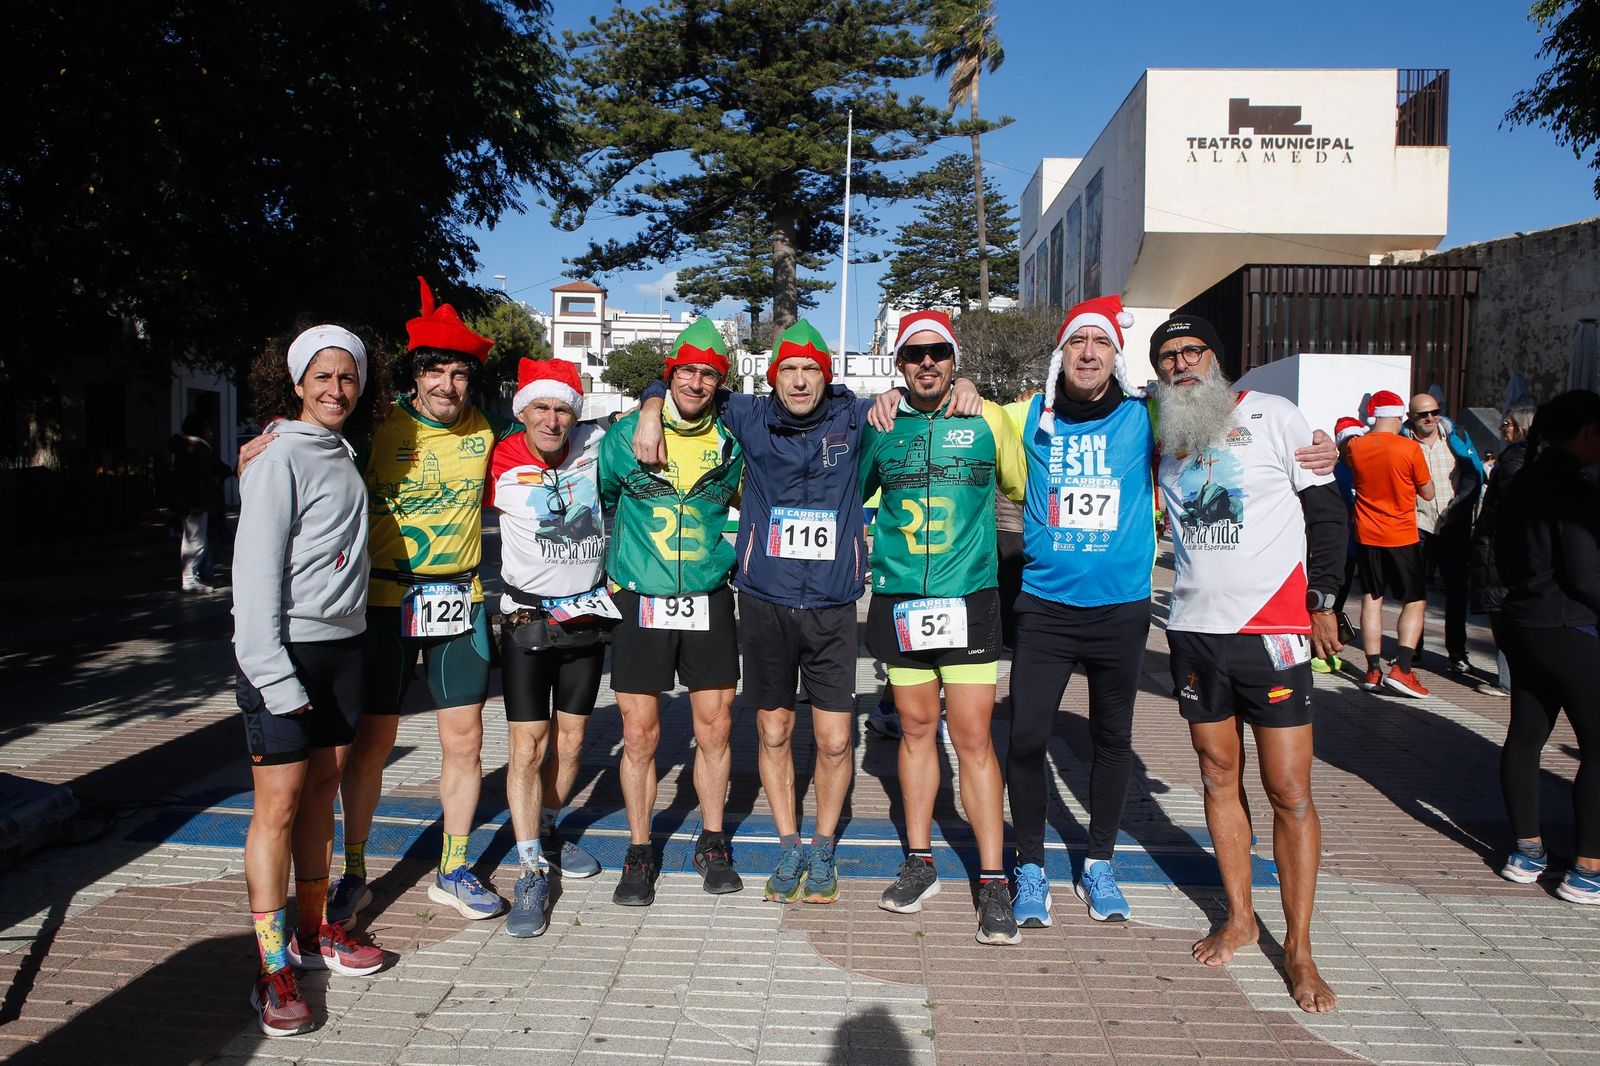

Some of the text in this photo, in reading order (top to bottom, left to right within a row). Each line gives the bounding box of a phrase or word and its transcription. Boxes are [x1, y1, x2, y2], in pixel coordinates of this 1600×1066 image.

[1187, 137, 1354, 150] TEATRO MUNICIPAL
[1187, 151, 1353, 164] ALAMEDA
[1067, 435, 1107, 453] SAN
[1066, 451, 1112, 477] SIL
[1065, 477, 1118, 487] CARRERA
[787, 510, 835, 519] CARRERA
[1064, 493, 1111, 516] 137
[785, 525, 828, 547] 116
[1210, 519, 1240, 544] vida
[538, 539, 565, 559] Vive
[566, 538, 579, 560] la
[422, 600, 465, 622] 122
[665, 596, 694, 617] 93
[921, 613, 951, 636] 52
